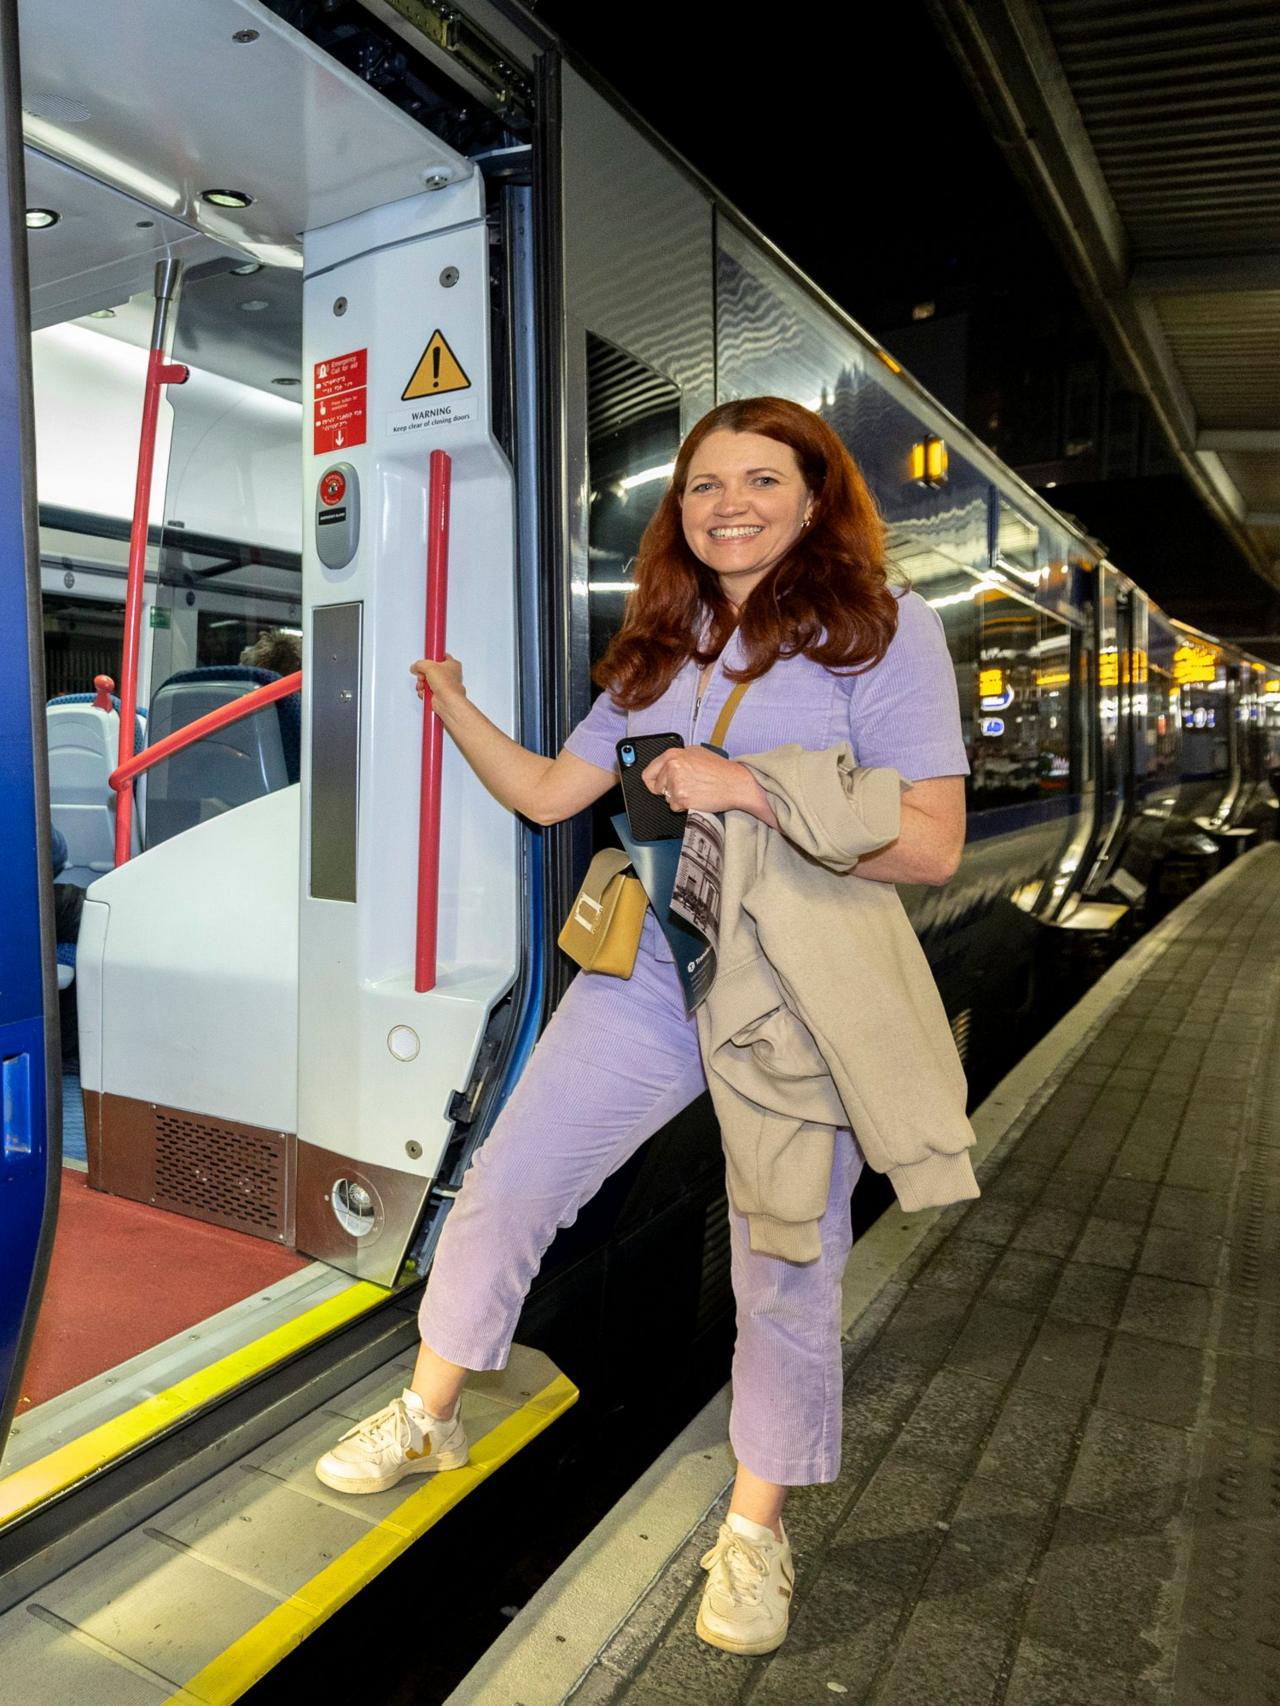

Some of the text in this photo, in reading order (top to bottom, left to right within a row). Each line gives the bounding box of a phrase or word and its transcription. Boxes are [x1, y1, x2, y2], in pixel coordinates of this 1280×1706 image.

[411, 406, 452, 420] WARNING
[393, 425, 407, 433] Keep
[408, 421, 422, 430] clear
[431, 417, 452, 426] closing
[453, 414, 470, 422] doors
